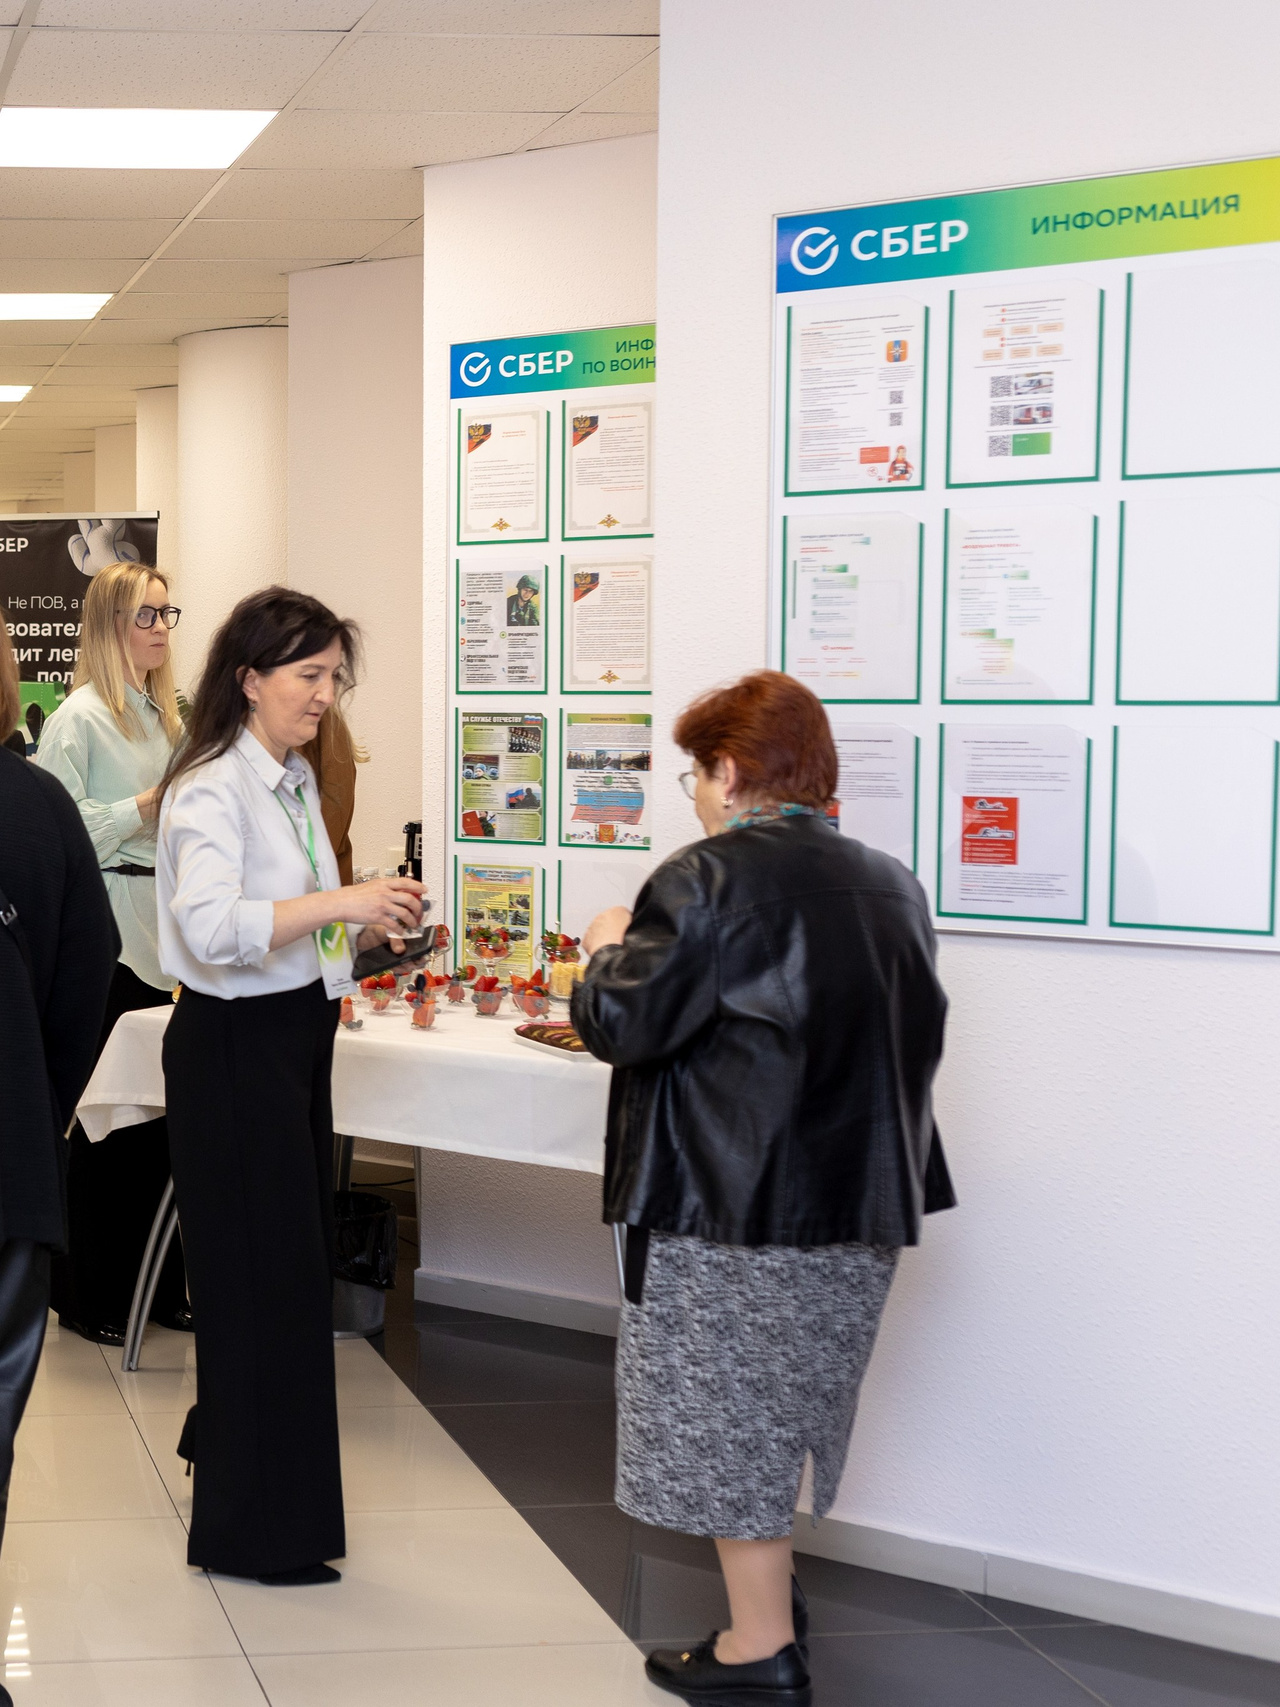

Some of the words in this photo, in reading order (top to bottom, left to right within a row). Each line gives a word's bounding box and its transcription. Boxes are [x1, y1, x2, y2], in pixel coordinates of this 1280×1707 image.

[1031, 193, 1241, 235] ИНФОРМАЦИЯ
[850, 219, 969, 261] СБЕР
[616, 338, 656, 354] ИНФ
[499, 350, 574, 378] СБЕР
[582, 360, 606, 375] ПО
[610, 356, 656, 372] ВОИН
[8, 596, 27, 609] Не
[31, 596, 67, 611] ПОВ,
[70, 599, 79, 609] а
